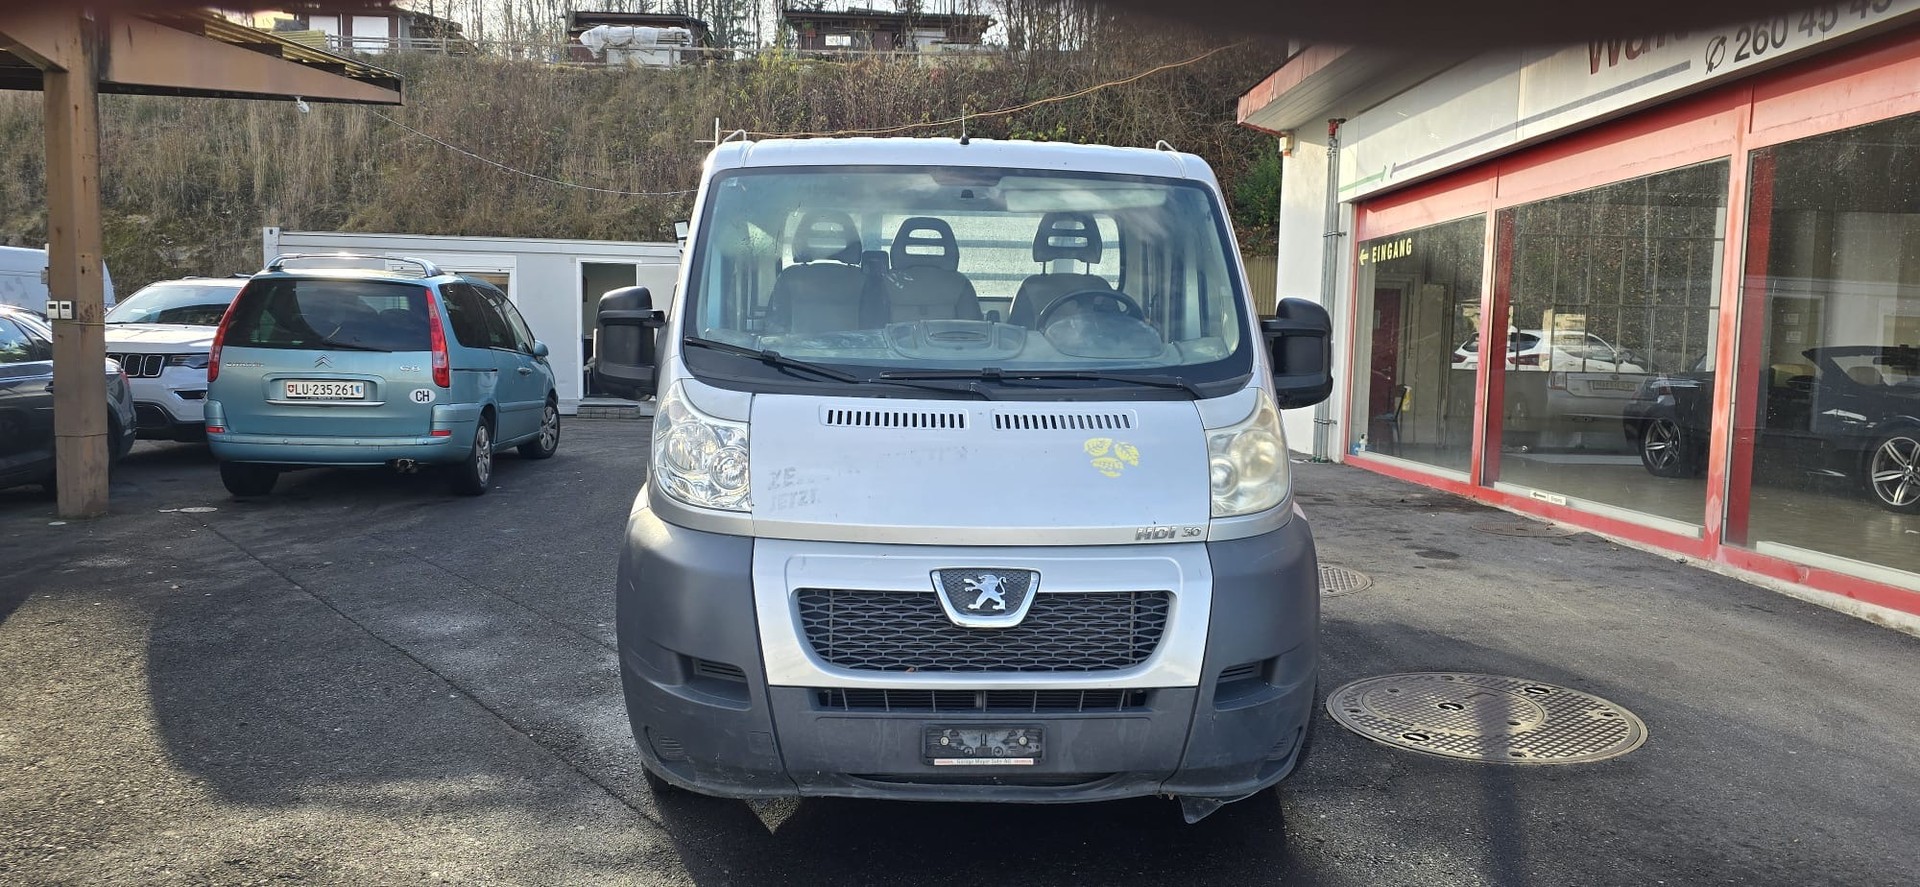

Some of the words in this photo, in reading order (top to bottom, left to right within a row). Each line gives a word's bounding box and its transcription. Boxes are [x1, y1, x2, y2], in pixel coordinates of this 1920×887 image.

[1734, 17, 1788, 63] 260
[1372, 237, 1412, 263] EINGANG
[415, 390, 430, 402] CH
